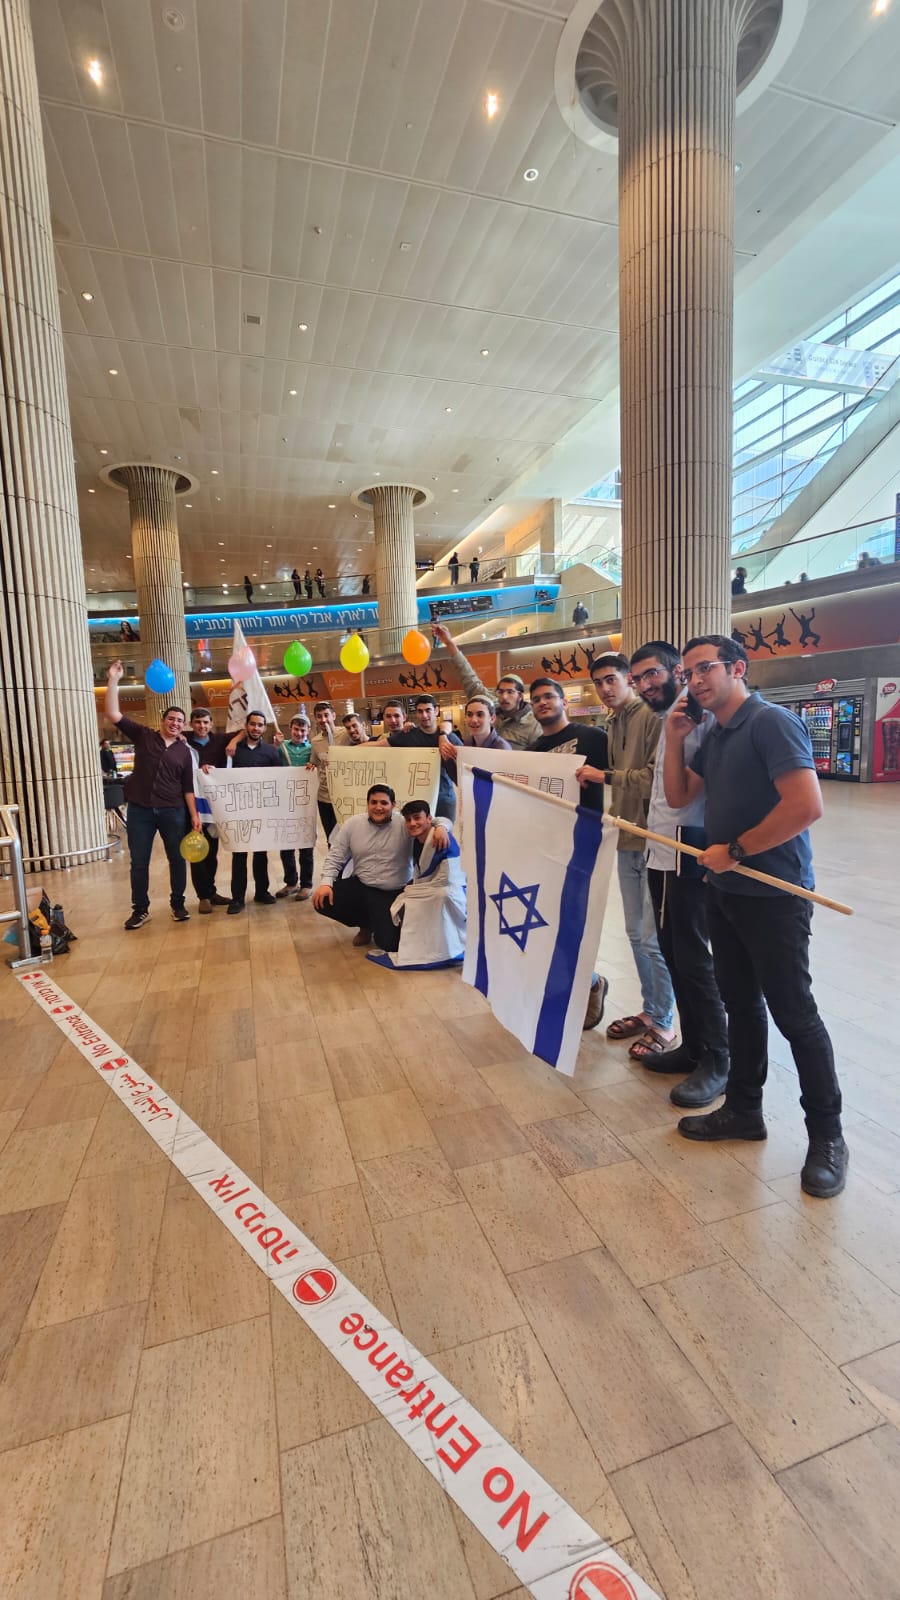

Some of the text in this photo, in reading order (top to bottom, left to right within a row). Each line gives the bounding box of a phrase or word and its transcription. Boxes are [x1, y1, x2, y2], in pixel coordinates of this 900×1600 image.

[265, 615, 287, 627] יותר
[290, 613, 308, 628] כיף
[310, 611, 332, 624] אבל
[287, 779, 310, 812] בן
[408, 762, 431, 796] בן
[216, 819, 262, 845] ישרא
[65, 1014, 113, 1058] No Entrance
[208, 1173, 300, 1265] אין כניסה
[339, 1312, 551, 1553] No Entrance
